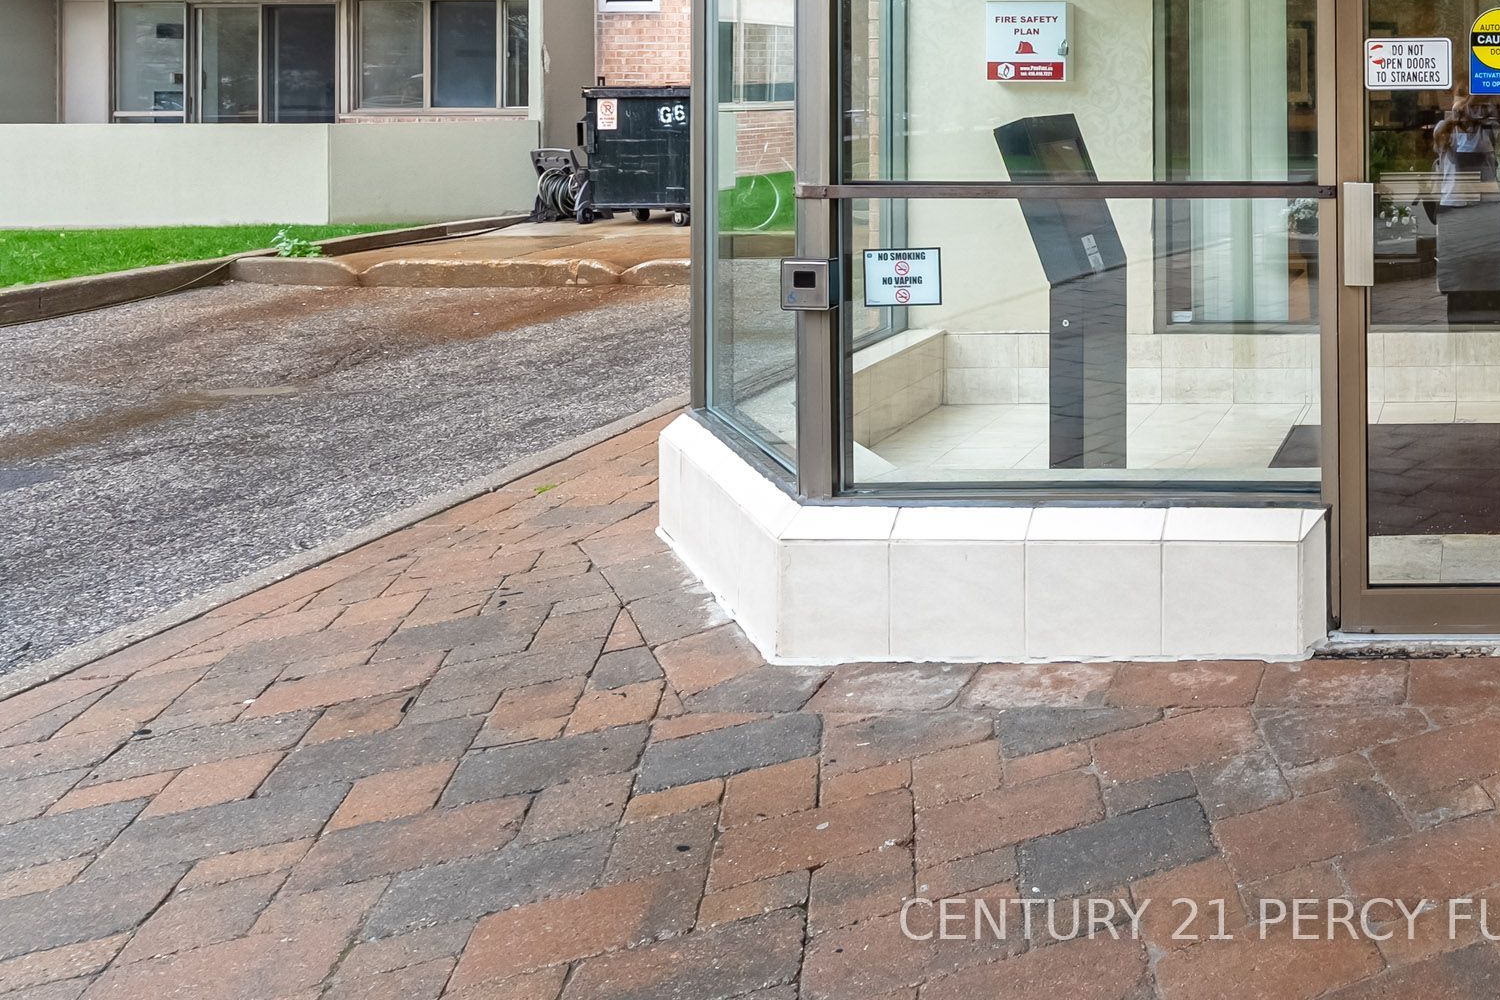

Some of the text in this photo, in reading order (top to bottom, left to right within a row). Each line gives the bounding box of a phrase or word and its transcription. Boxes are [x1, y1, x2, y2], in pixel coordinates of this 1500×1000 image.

[1391, 44, 1424, 56] DO NOT
[1380, 58, 1436, 69] OPEN DOORS
[1376, 71, 1440, 83] TO STRANGERS
[660, 104, 686, 123] G6
[878, 251, 926, 261] NO SMOKING
[882, 275, 923, 285] NO VAPING
